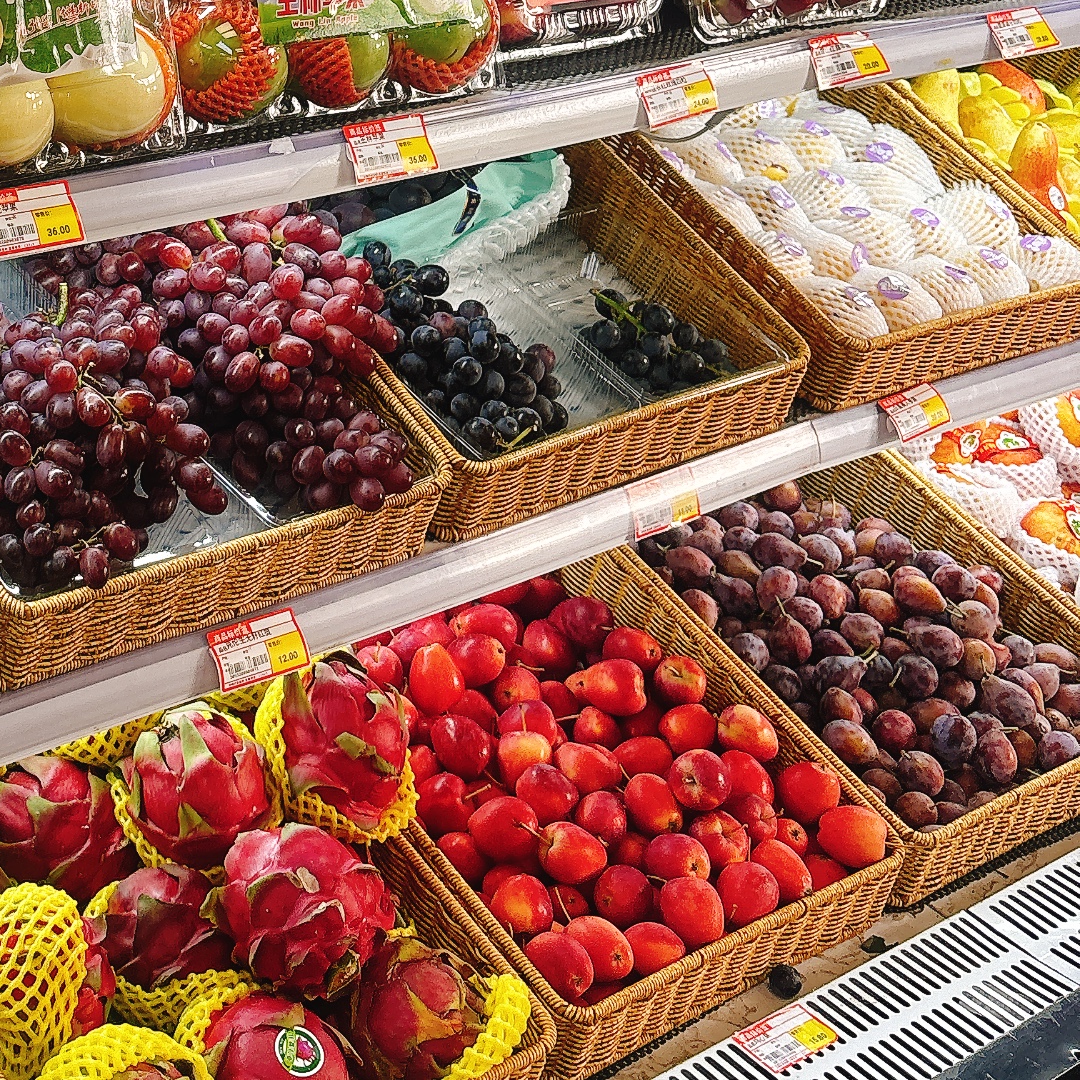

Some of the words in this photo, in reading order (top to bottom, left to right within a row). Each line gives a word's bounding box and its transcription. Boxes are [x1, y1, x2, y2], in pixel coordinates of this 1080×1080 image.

[291, 19, 315, 29] Wang
[408, 154, 428, 165] 35.00
[46, 224, 71, 237] 36.00
[278, 650, 299, 665] 12.00
